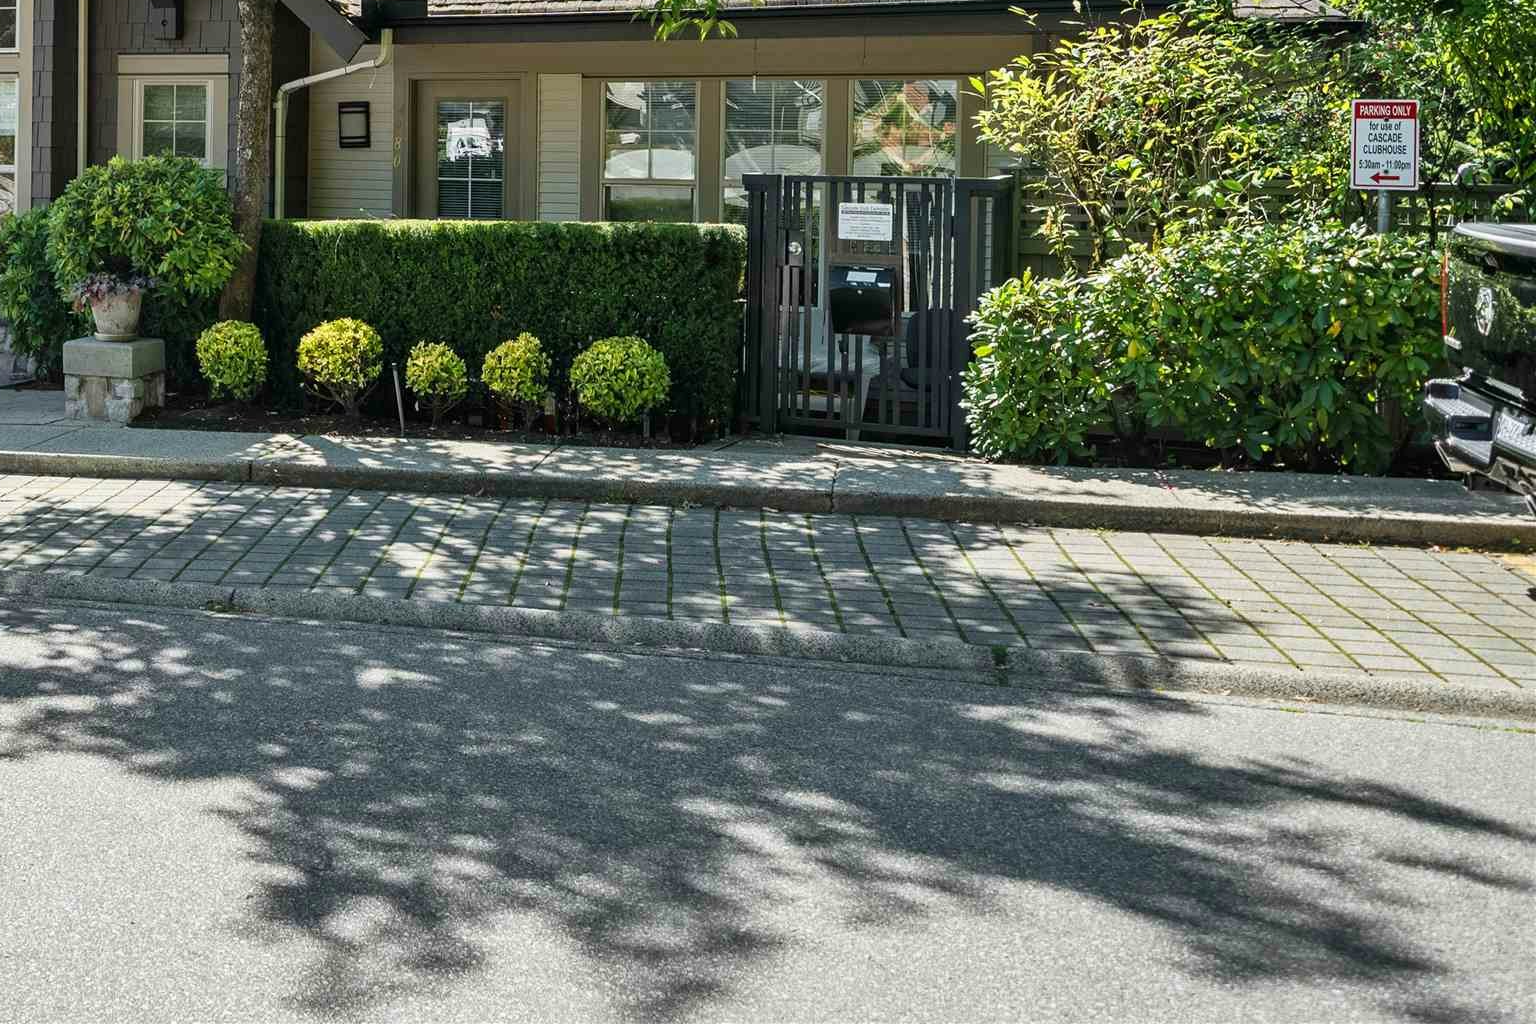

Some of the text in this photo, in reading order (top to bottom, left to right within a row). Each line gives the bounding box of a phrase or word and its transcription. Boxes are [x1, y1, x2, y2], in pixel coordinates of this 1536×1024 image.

[1360, 105, 1411, 115] PARKING ONLY
[1369, 121, 1402, 131] for use of
[1368, 133, 1402, 142] CASCADE
[1363, 145, 1407, 154] CLUBHOUSE
